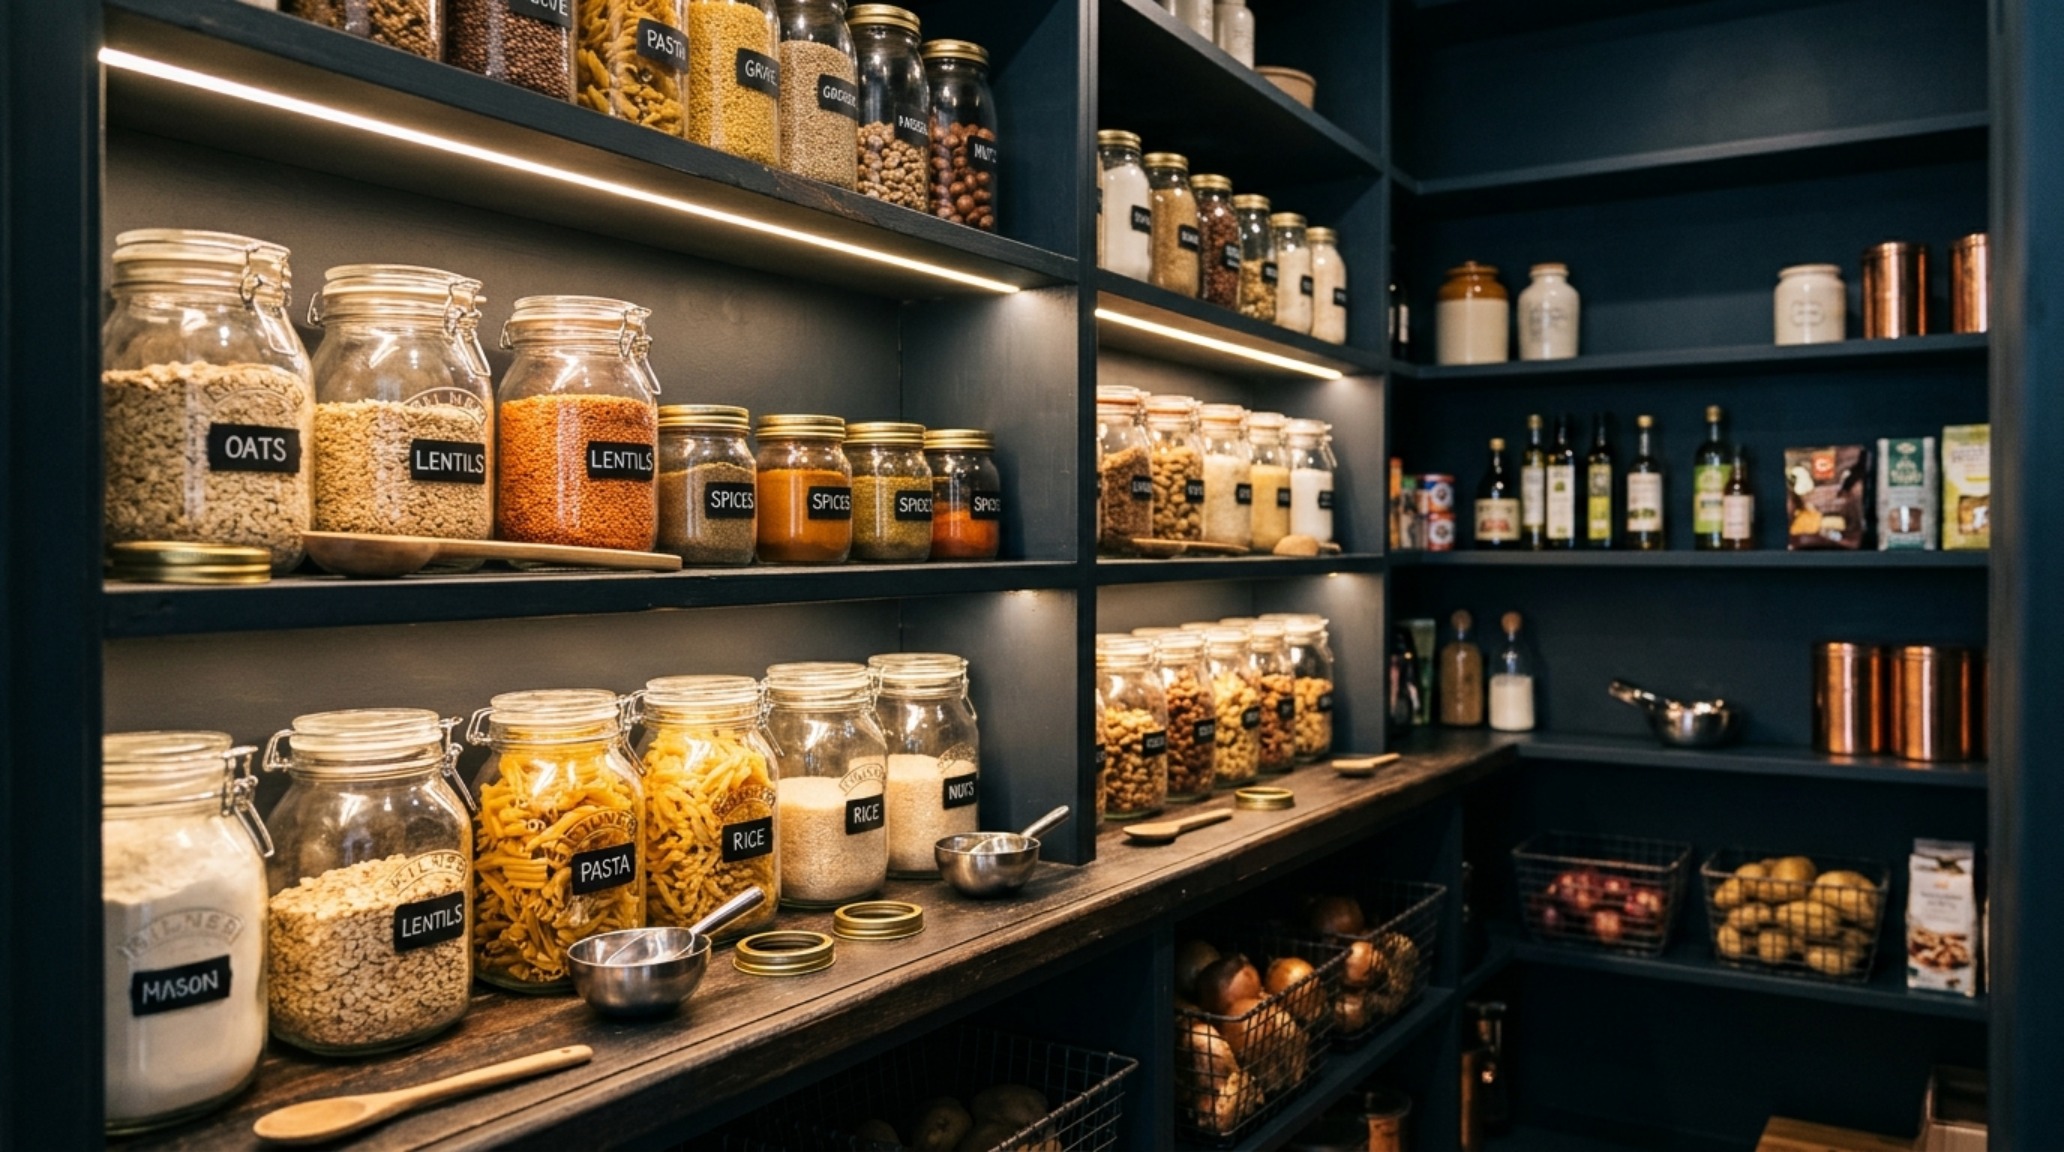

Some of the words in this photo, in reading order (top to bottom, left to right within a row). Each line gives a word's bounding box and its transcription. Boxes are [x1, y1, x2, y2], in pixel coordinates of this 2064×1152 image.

[225, 435, 287, 462] OATS
[416, 450, 485, 474] LENTILS
[591, 450, 653, 471] LENTILS
[710, 490, 754, 510] SPICES
[812, 492, 850, 511] SPICES
[854, 804, 880, 824] RICE
[734, 828, 765, 851] RICE
[580, 854, 631, 883] PASTA
[401, 903, 462, 938] LENTILS
[142, 969, 219, 1005] MASON
